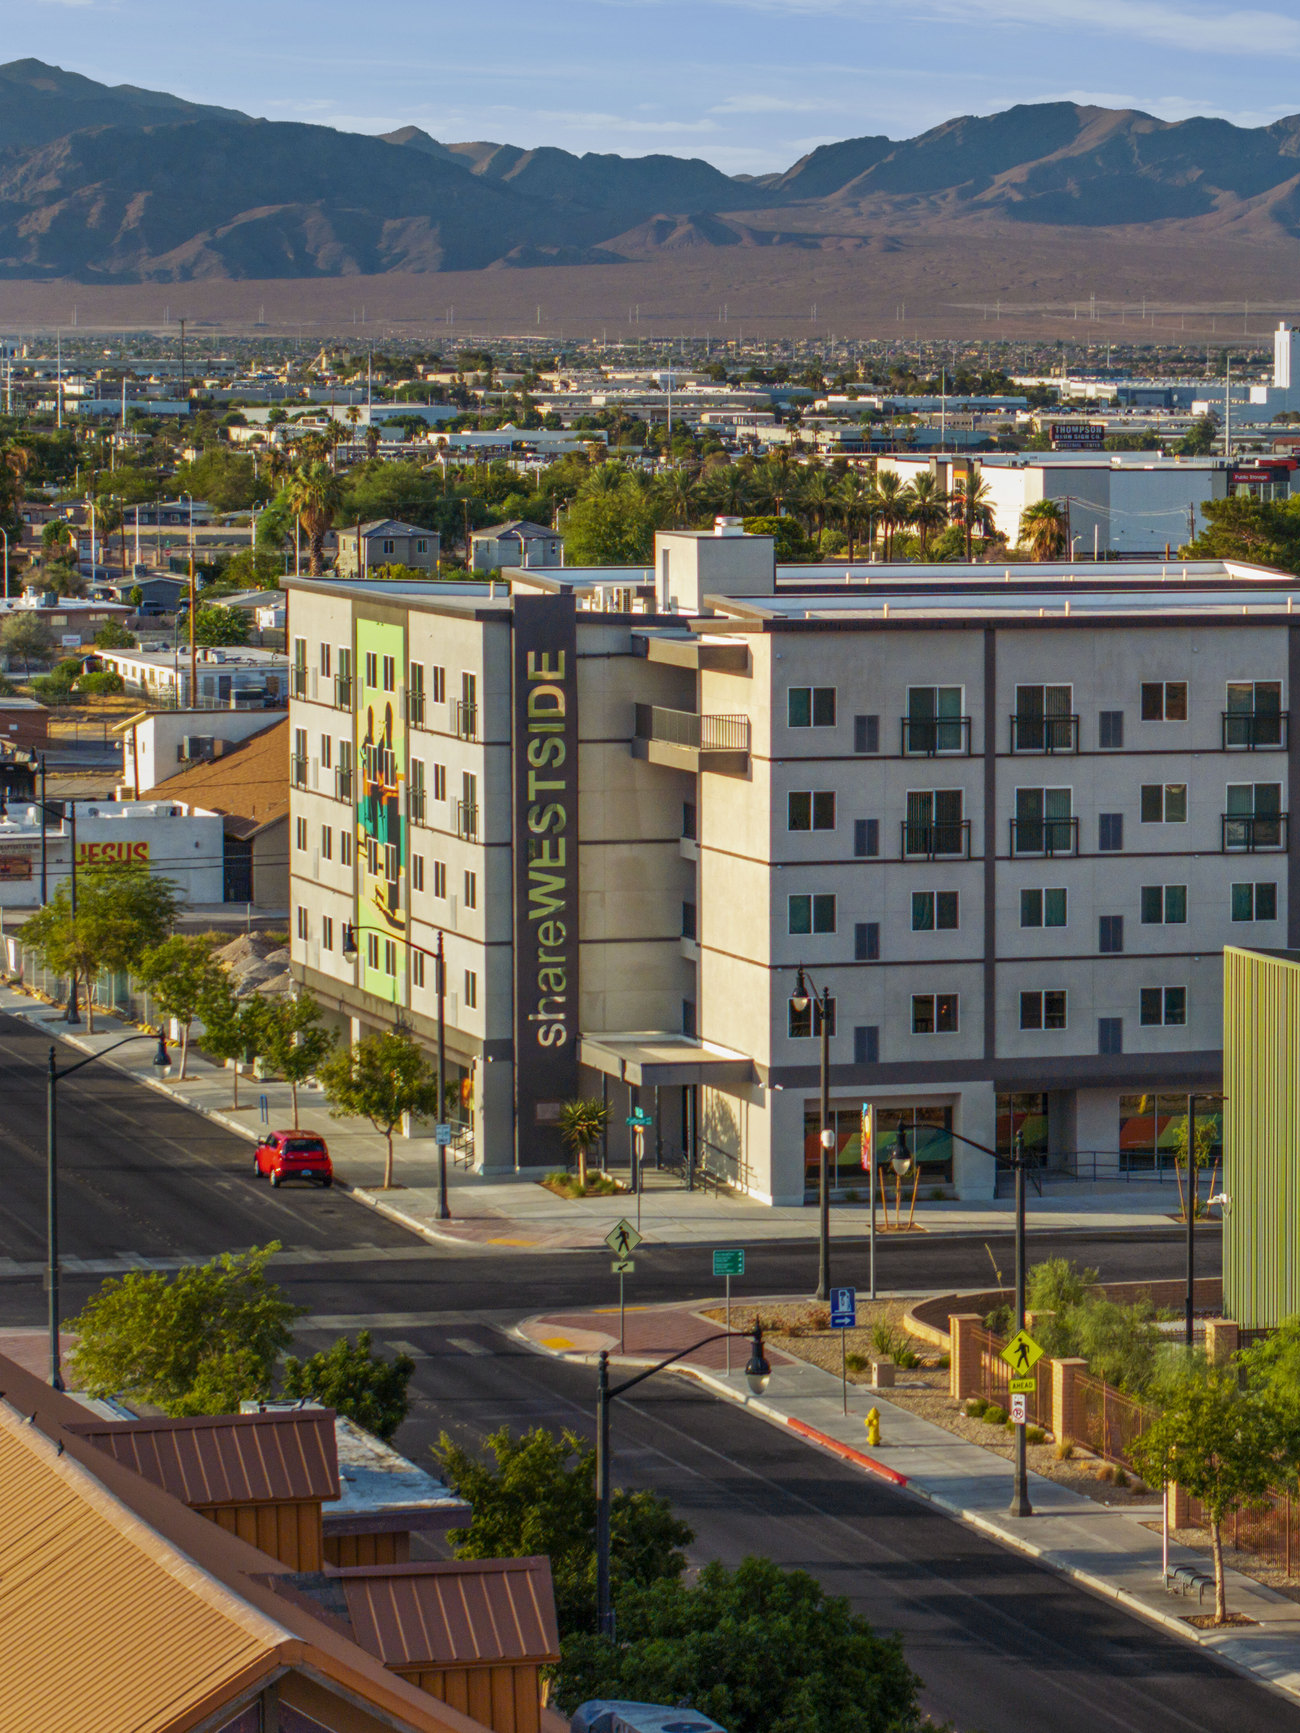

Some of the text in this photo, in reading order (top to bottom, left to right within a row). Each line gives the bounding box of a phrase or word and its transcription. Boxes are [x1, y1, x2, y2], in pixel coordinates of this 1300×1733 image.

[1054, 425, 1102, 434] THOMPSON
[75, 842, 148, 866] JESUS
[527, 649, 567, 1048] shareWESTSIDE
[1012, 1381, 1034, 1390] AHEAD
